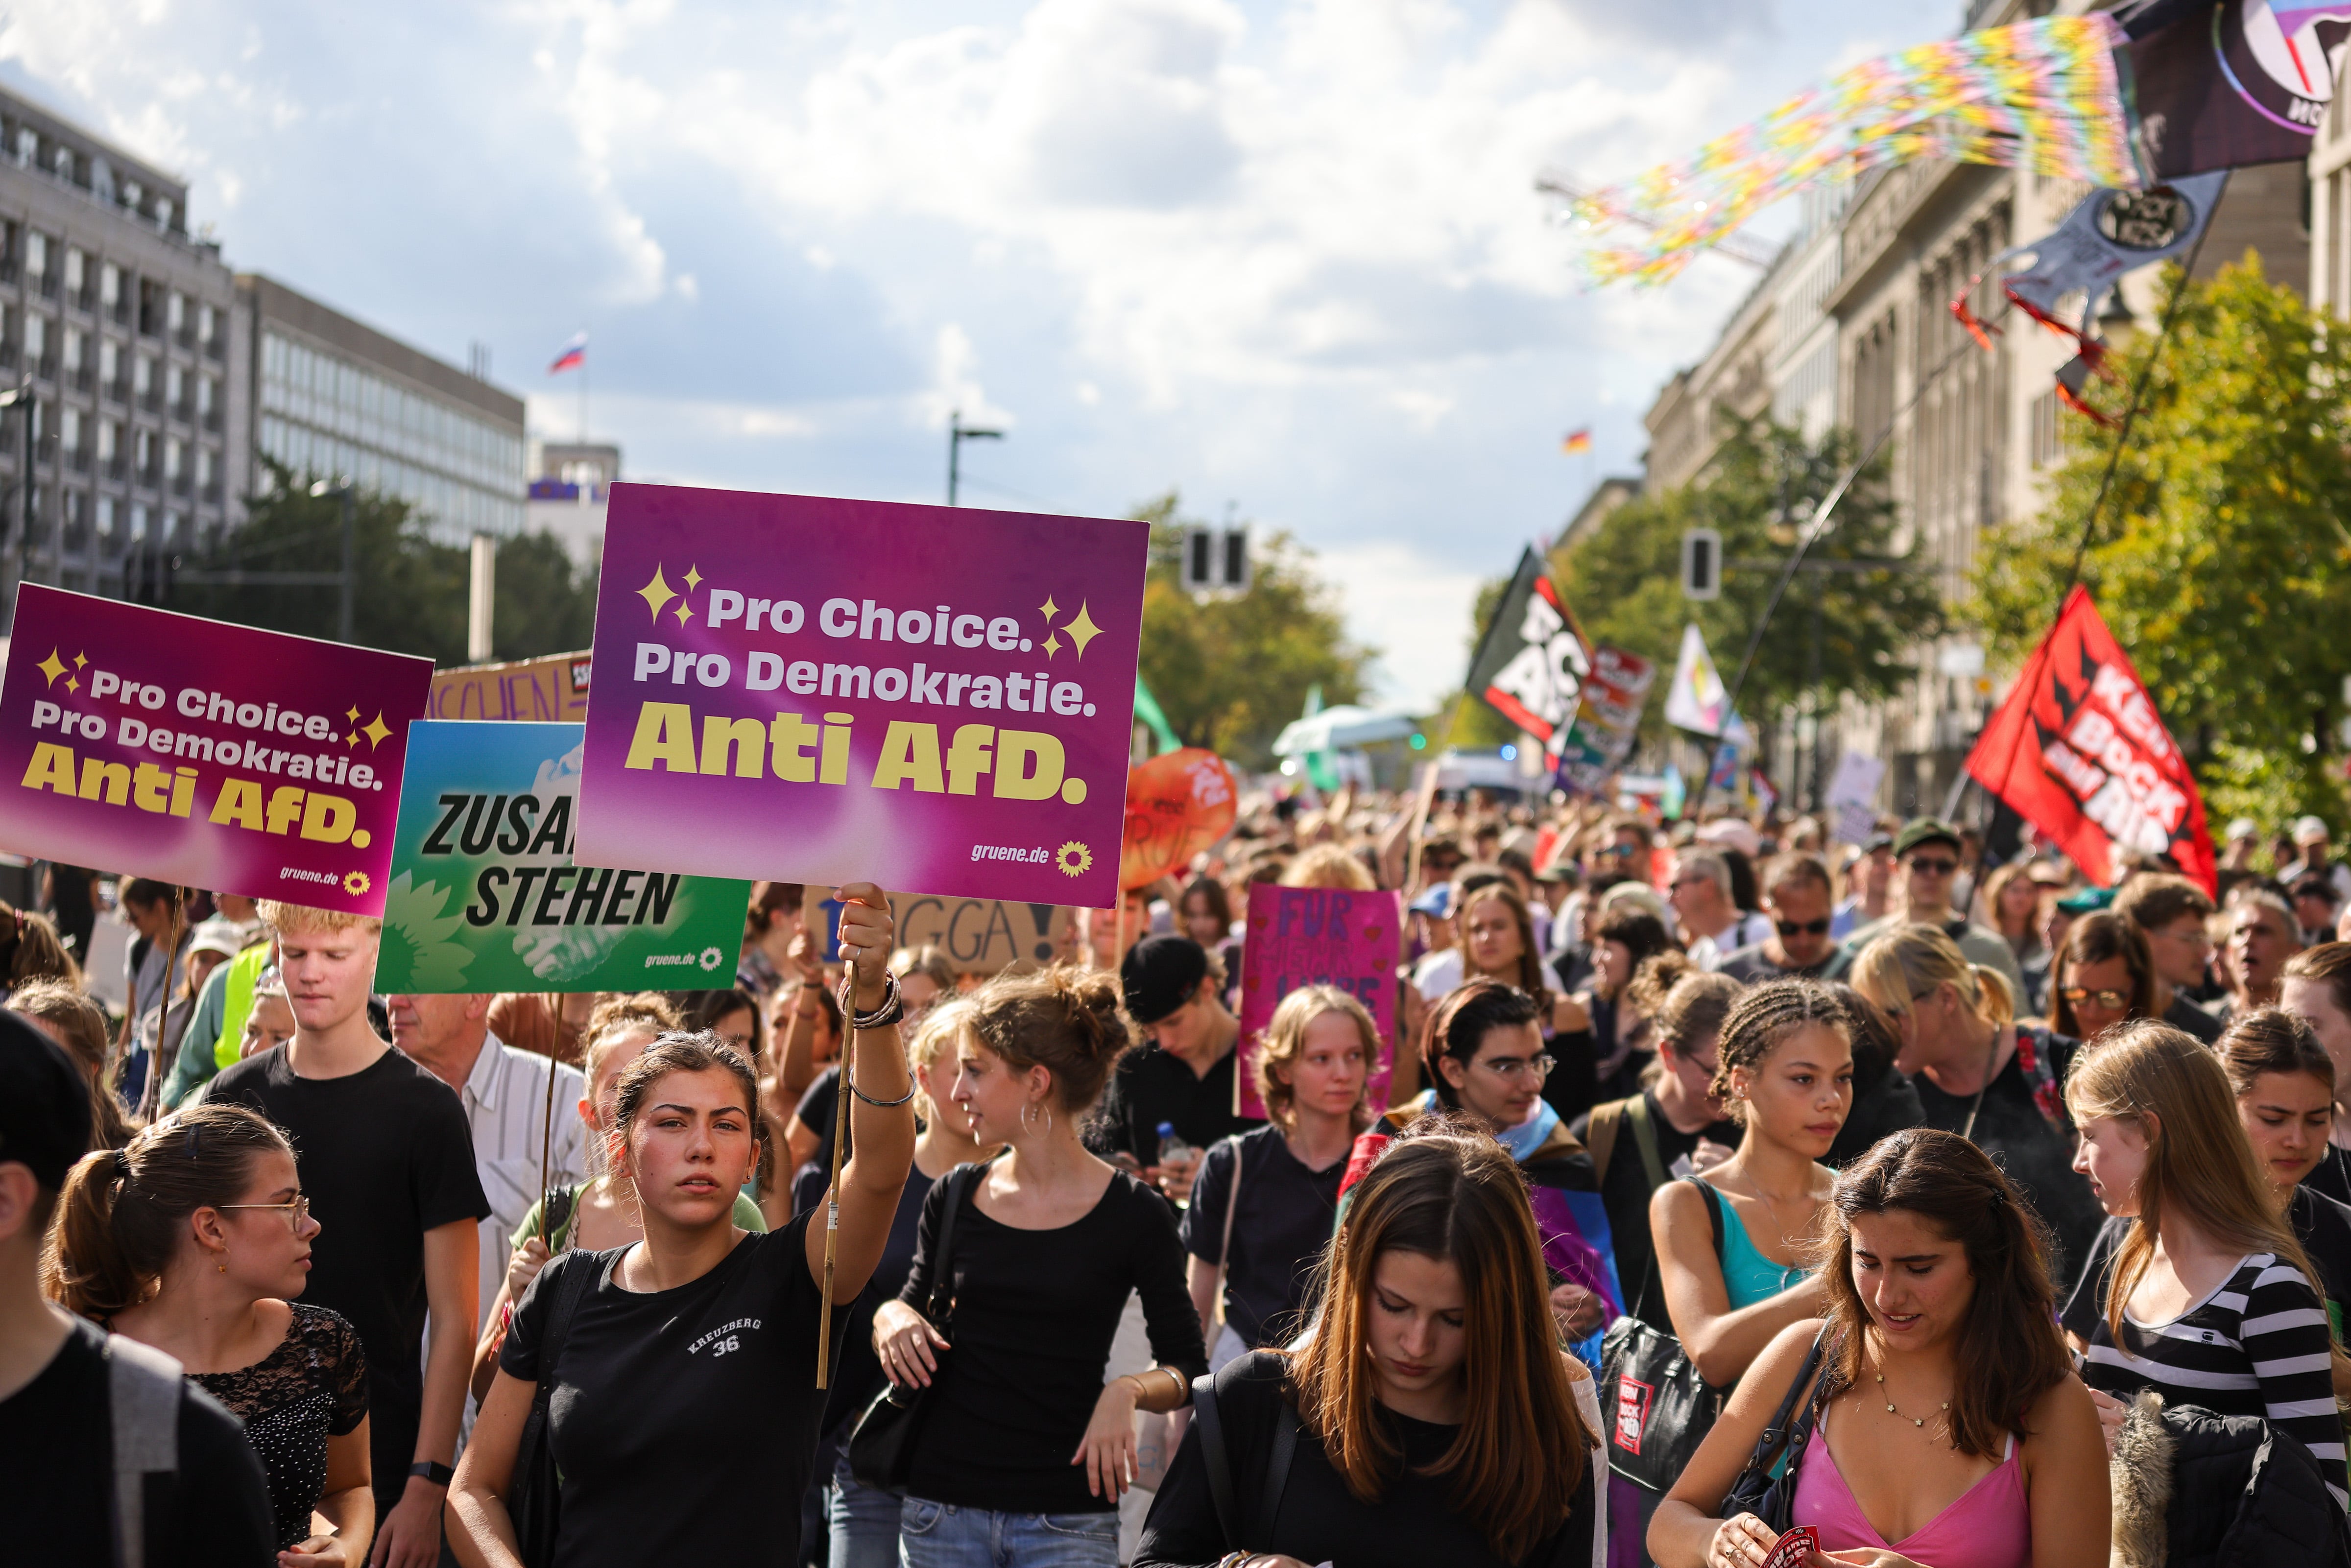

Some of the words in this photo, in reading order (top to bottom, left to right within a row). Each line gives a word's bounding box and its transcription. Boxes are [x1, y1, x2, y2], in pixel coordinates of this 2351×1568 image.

[707, 589, 805, 634] Pro
[819, 597, 1032, 652] Choice.
[90, 670, 166, 710] Pro
[177, 688, 338, 743] Choice.
[633, 642, 731, 688] Pro
[745, 651, 1096, 717] Demokratie.
[31, 700, 107, 740] Pro
[117, 717, 383, 791] Demokratie.
[625, 701, 854, 785] Anti
[871, 720, 1087, 805] AfD.
[22, 741, 198, 818] Anti
[209, 778, 371, 848] AfD.
[280, 866, 339, 886] gruene.de
[971, 844, 1049, 863] gruene.de
[466, 866, 681, 927] STEHEN
[644, 952, 696, 969] gruene.de
[687, 1318, 762, 1354] KREUZBERG
[713, 1335, 740, 1358] 36
